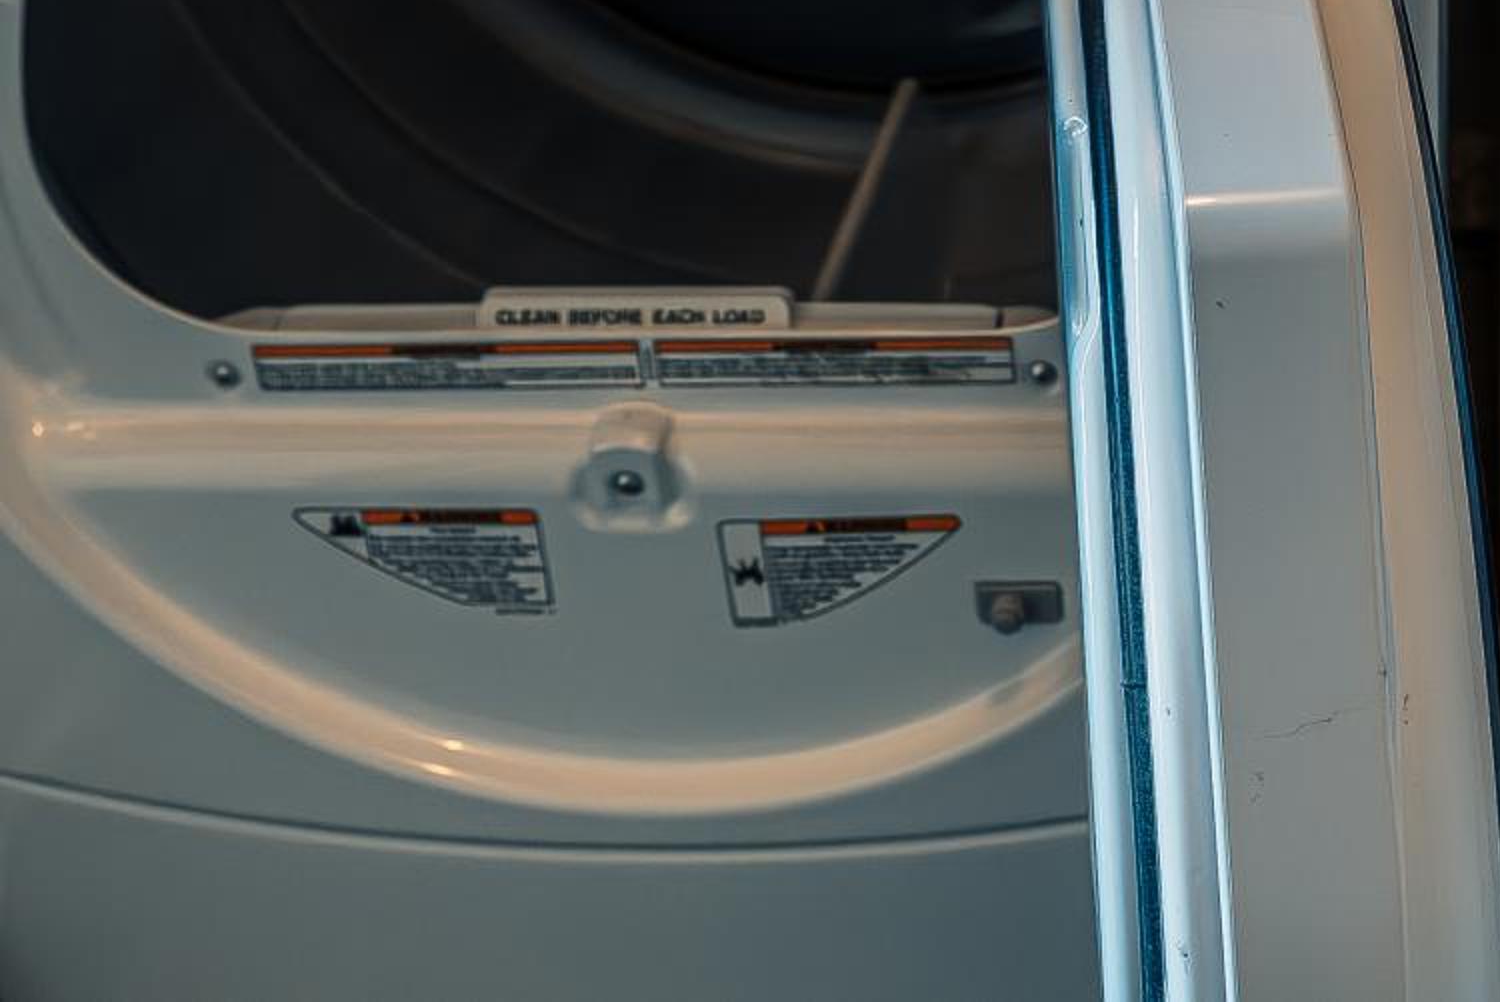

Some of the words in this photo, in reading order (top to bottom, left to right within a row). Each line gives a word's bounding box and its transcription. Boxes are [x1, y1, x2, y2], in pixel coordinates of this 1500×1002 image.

[495, 309, 560, 326] CLEAN
[566, 309, 641, 326] BEFORE
[653, 308, 706, 325] EACH
[712, 309, 766, 325] LOAD
